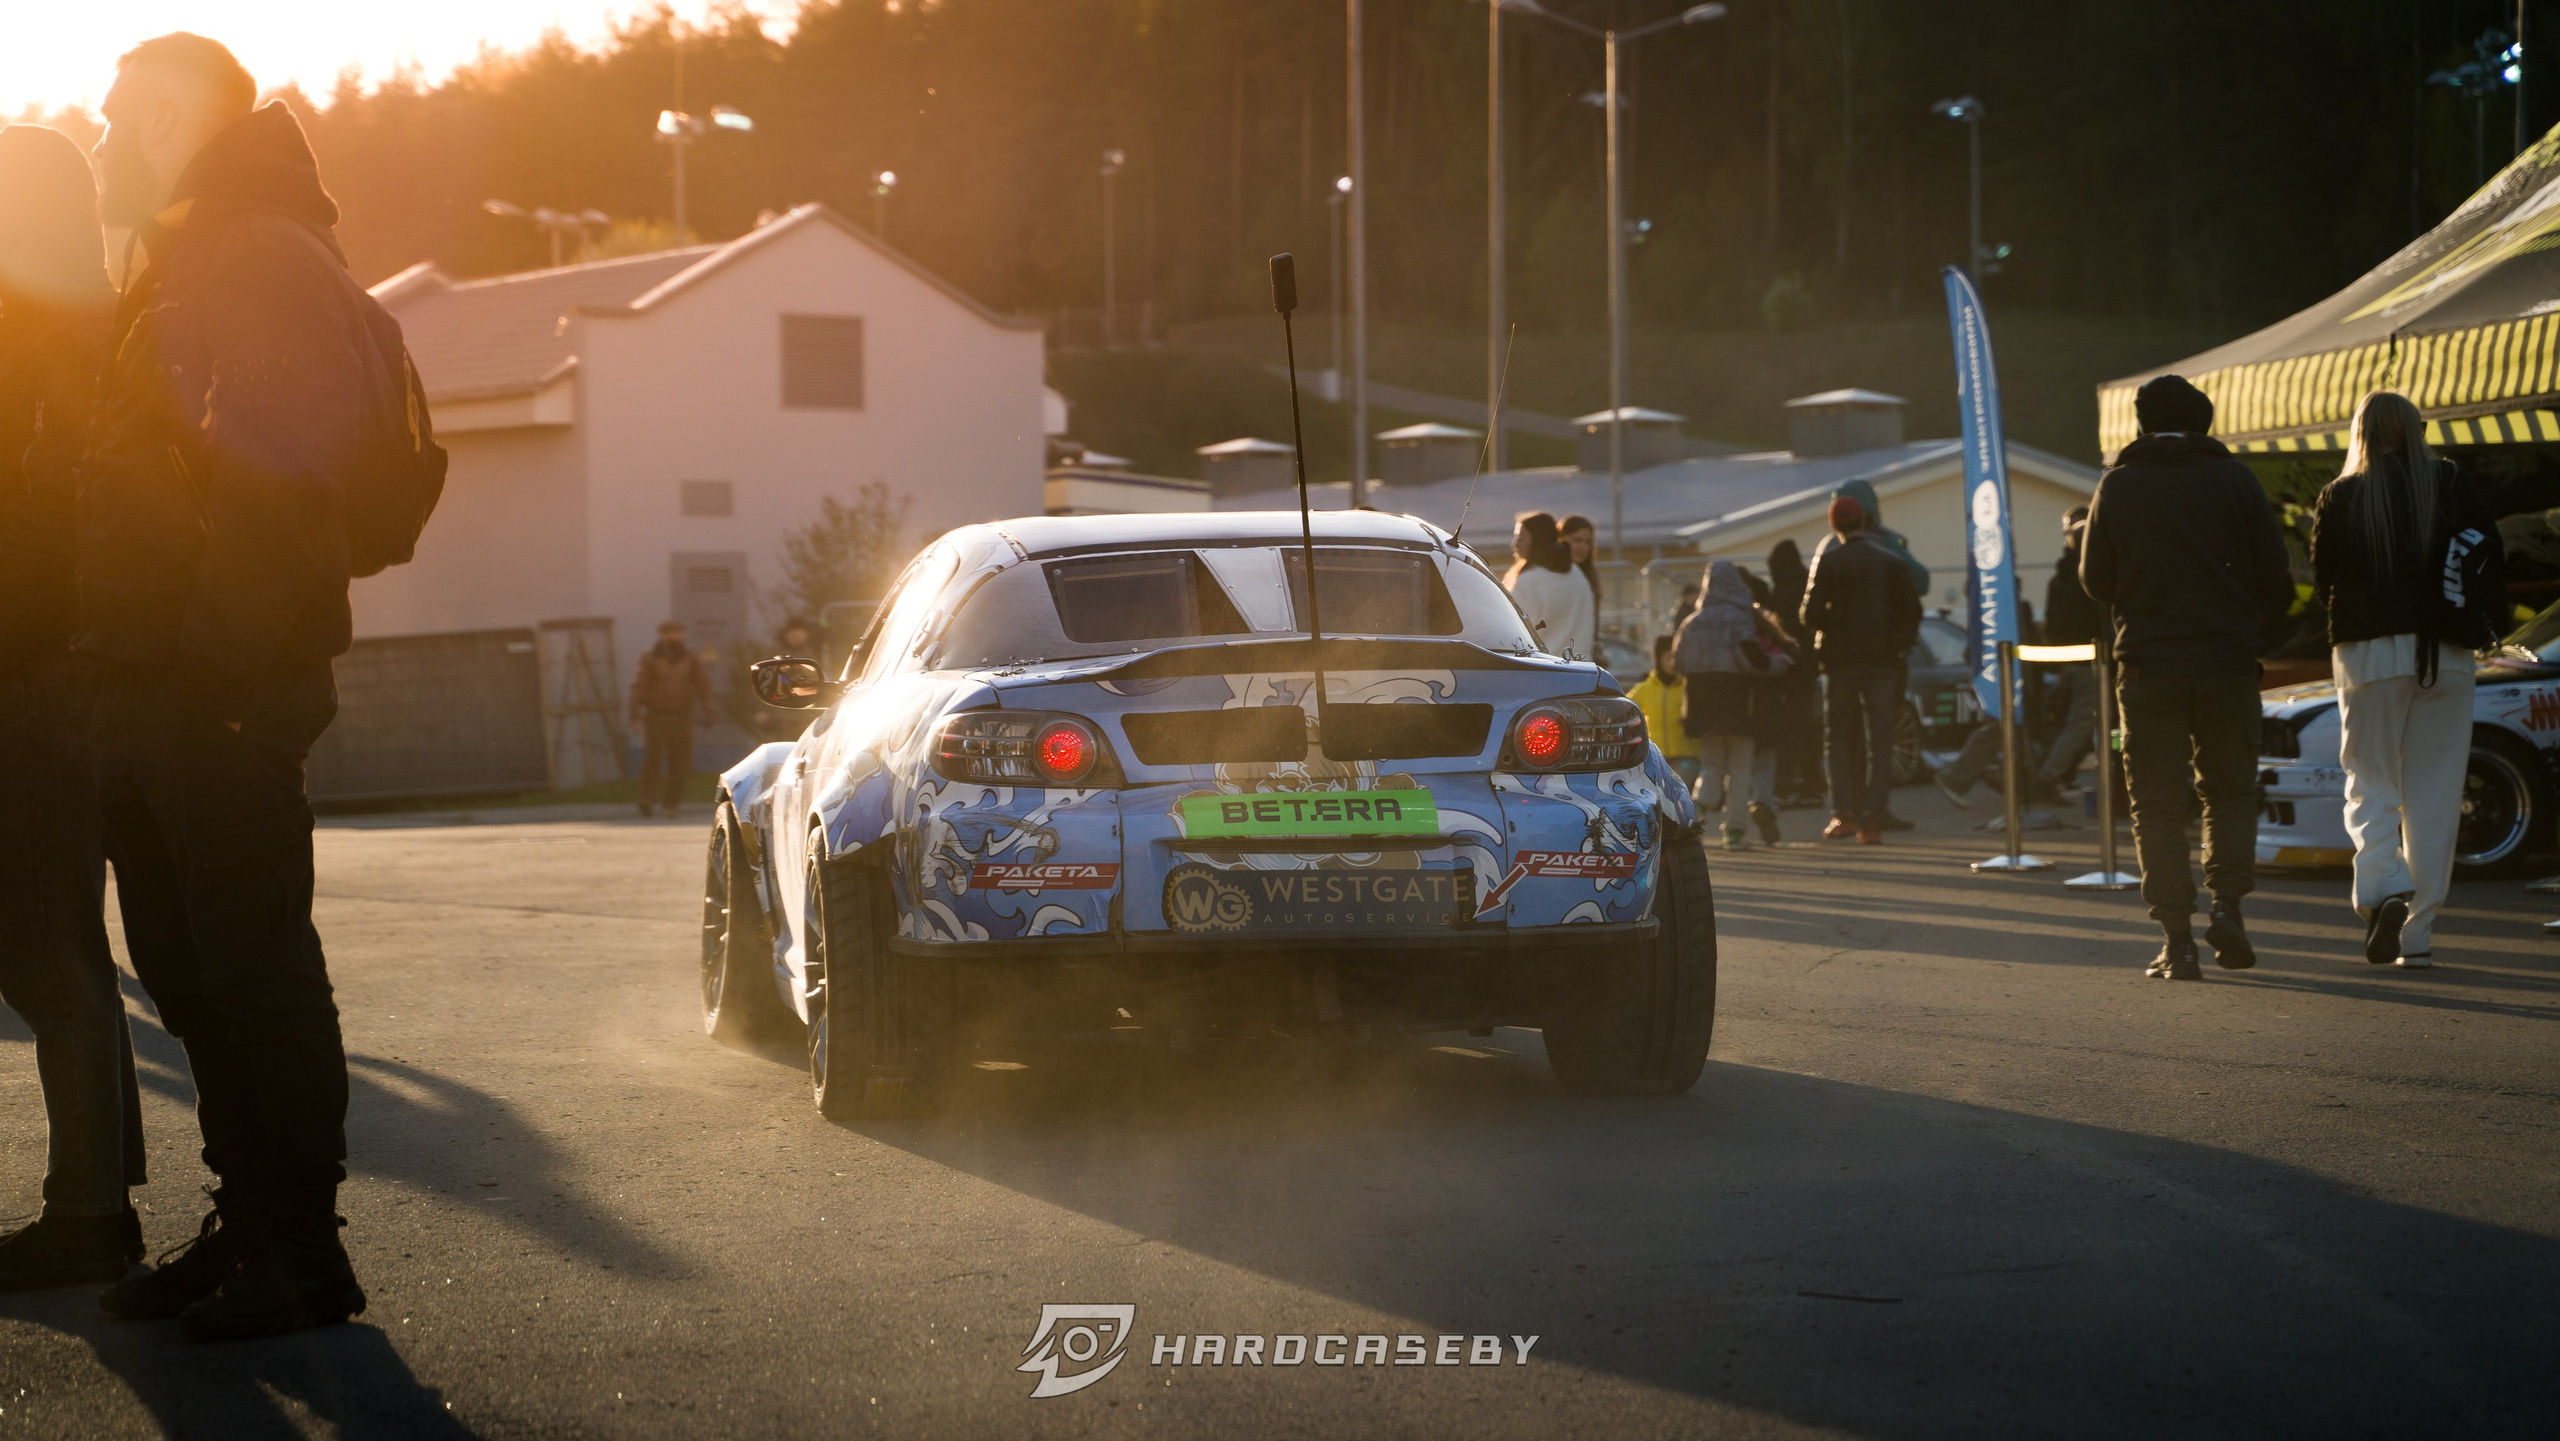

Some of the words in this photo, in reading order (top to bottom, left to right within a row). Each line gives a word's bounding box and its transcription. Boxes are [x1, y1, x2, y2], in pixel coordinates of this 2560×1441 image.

[986, 866, 1099, 878] РАКЕТА
[1261, 875, 1470, 903] WESTGATE
[1263, 912, 1470, 924] AUTOSERVICE
